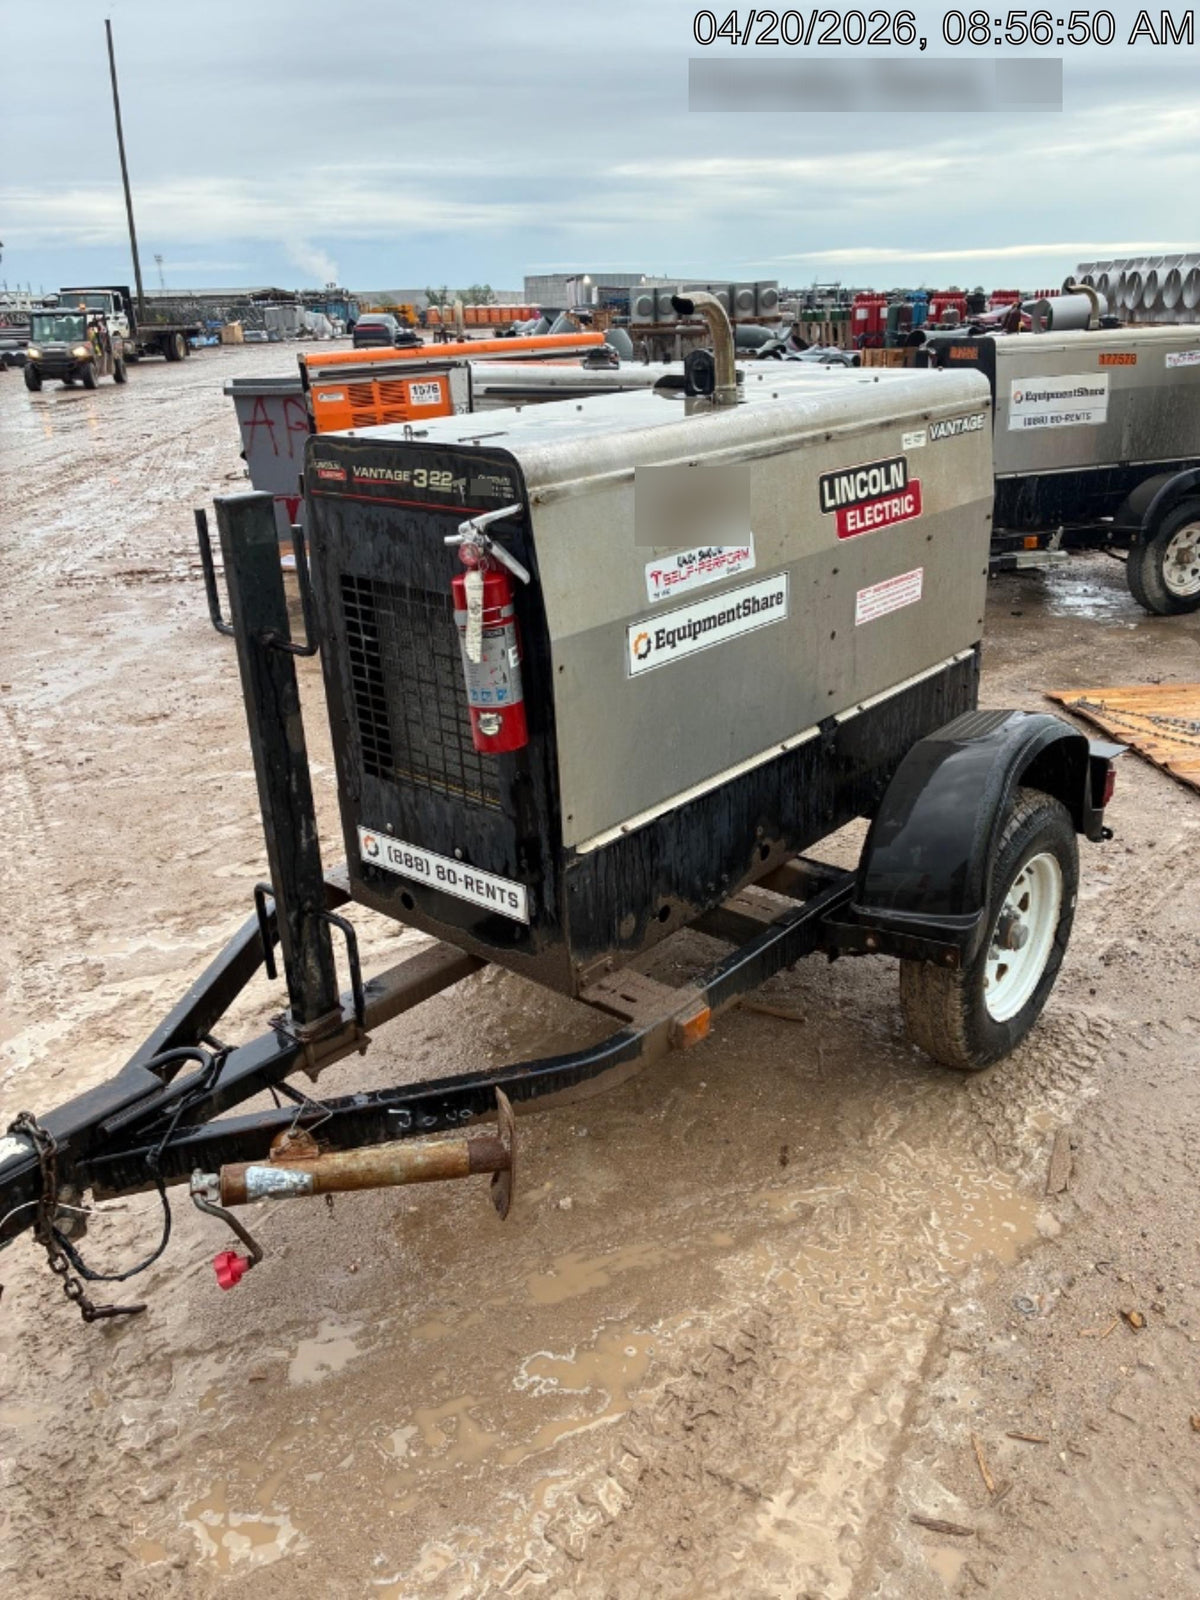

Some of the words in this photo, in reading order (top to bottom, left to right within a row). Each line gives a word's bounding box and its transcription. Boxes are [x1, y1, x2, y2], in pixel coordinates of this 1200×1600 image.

[1025, 387, 1105, 402] EquipmentShare
[928, 412, 987, 441] VANTAGE
[352, 465, 411, 482] VANTAGE
[822, 461, 905, 508] LINCOLN
[845, 494, 915, 532] ELECTRIC
[654, 591, 784, 650] EquipmentShare
[387, 845, 430, 876] (888)
[435, 865, 519, 909] 80-RENTS
